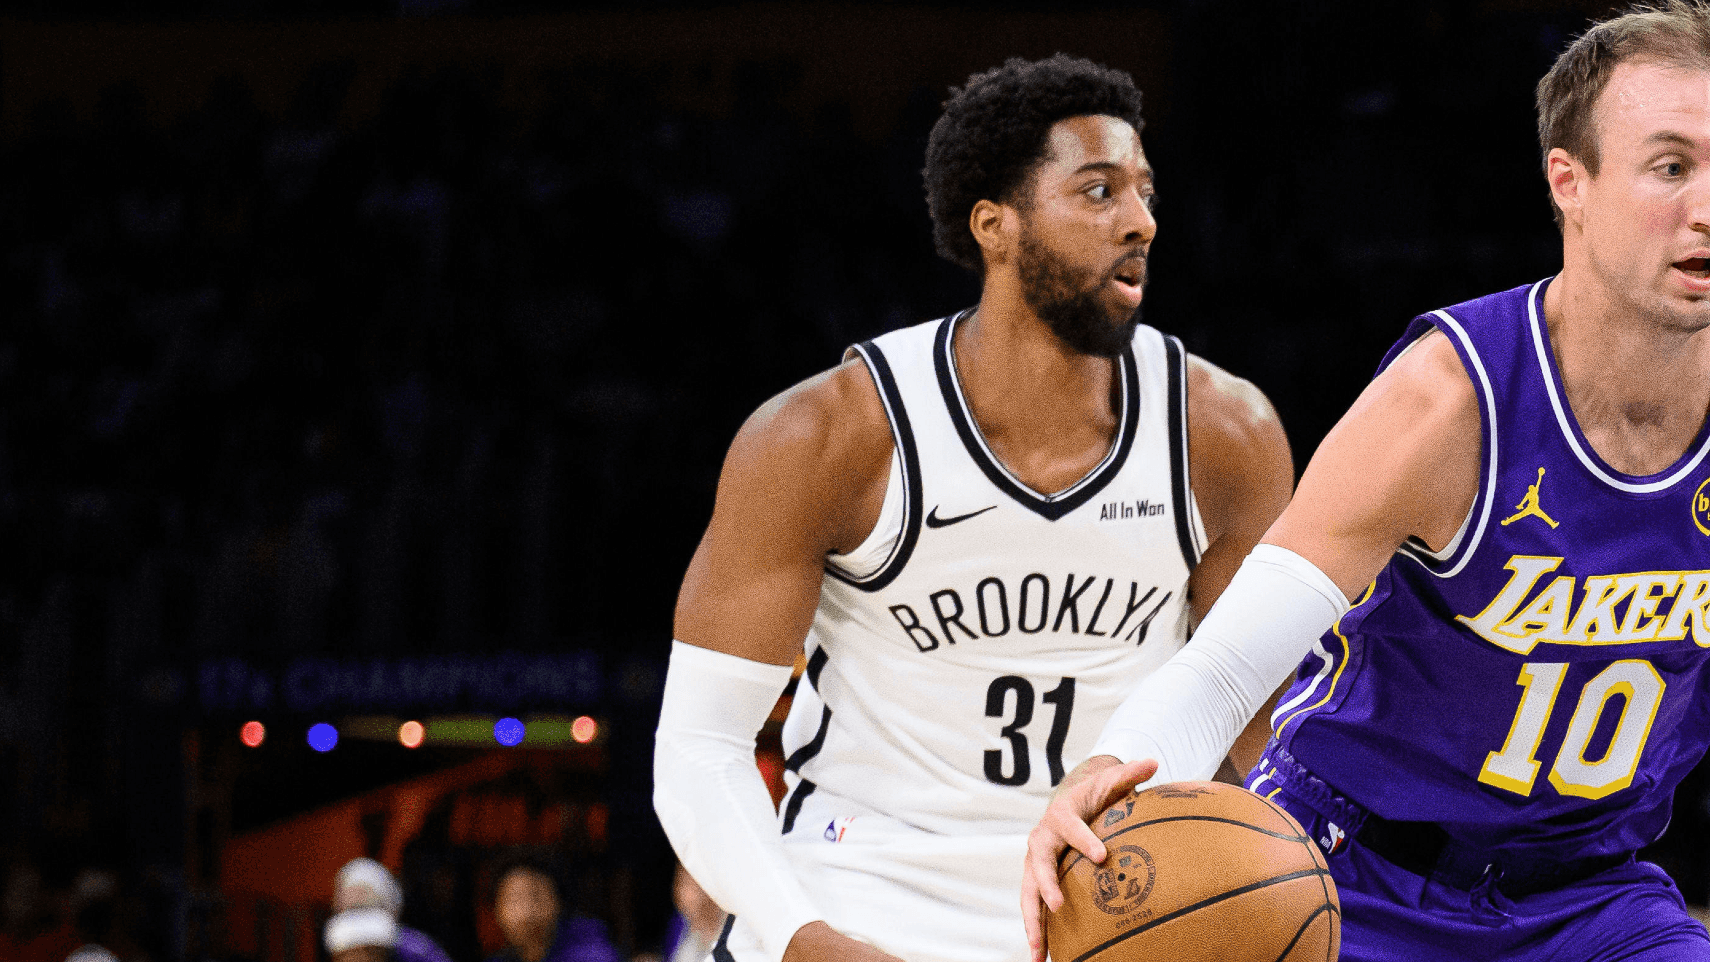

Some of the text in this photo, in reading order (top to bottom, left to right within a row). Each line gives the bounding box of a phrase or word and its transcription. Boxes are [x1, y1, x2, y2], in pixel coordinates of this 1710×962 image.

[1100, 499, 1165, 521] All In Won
[982, 675, 1076, 787] 31
[1477, 658, 1665, 801] 10
